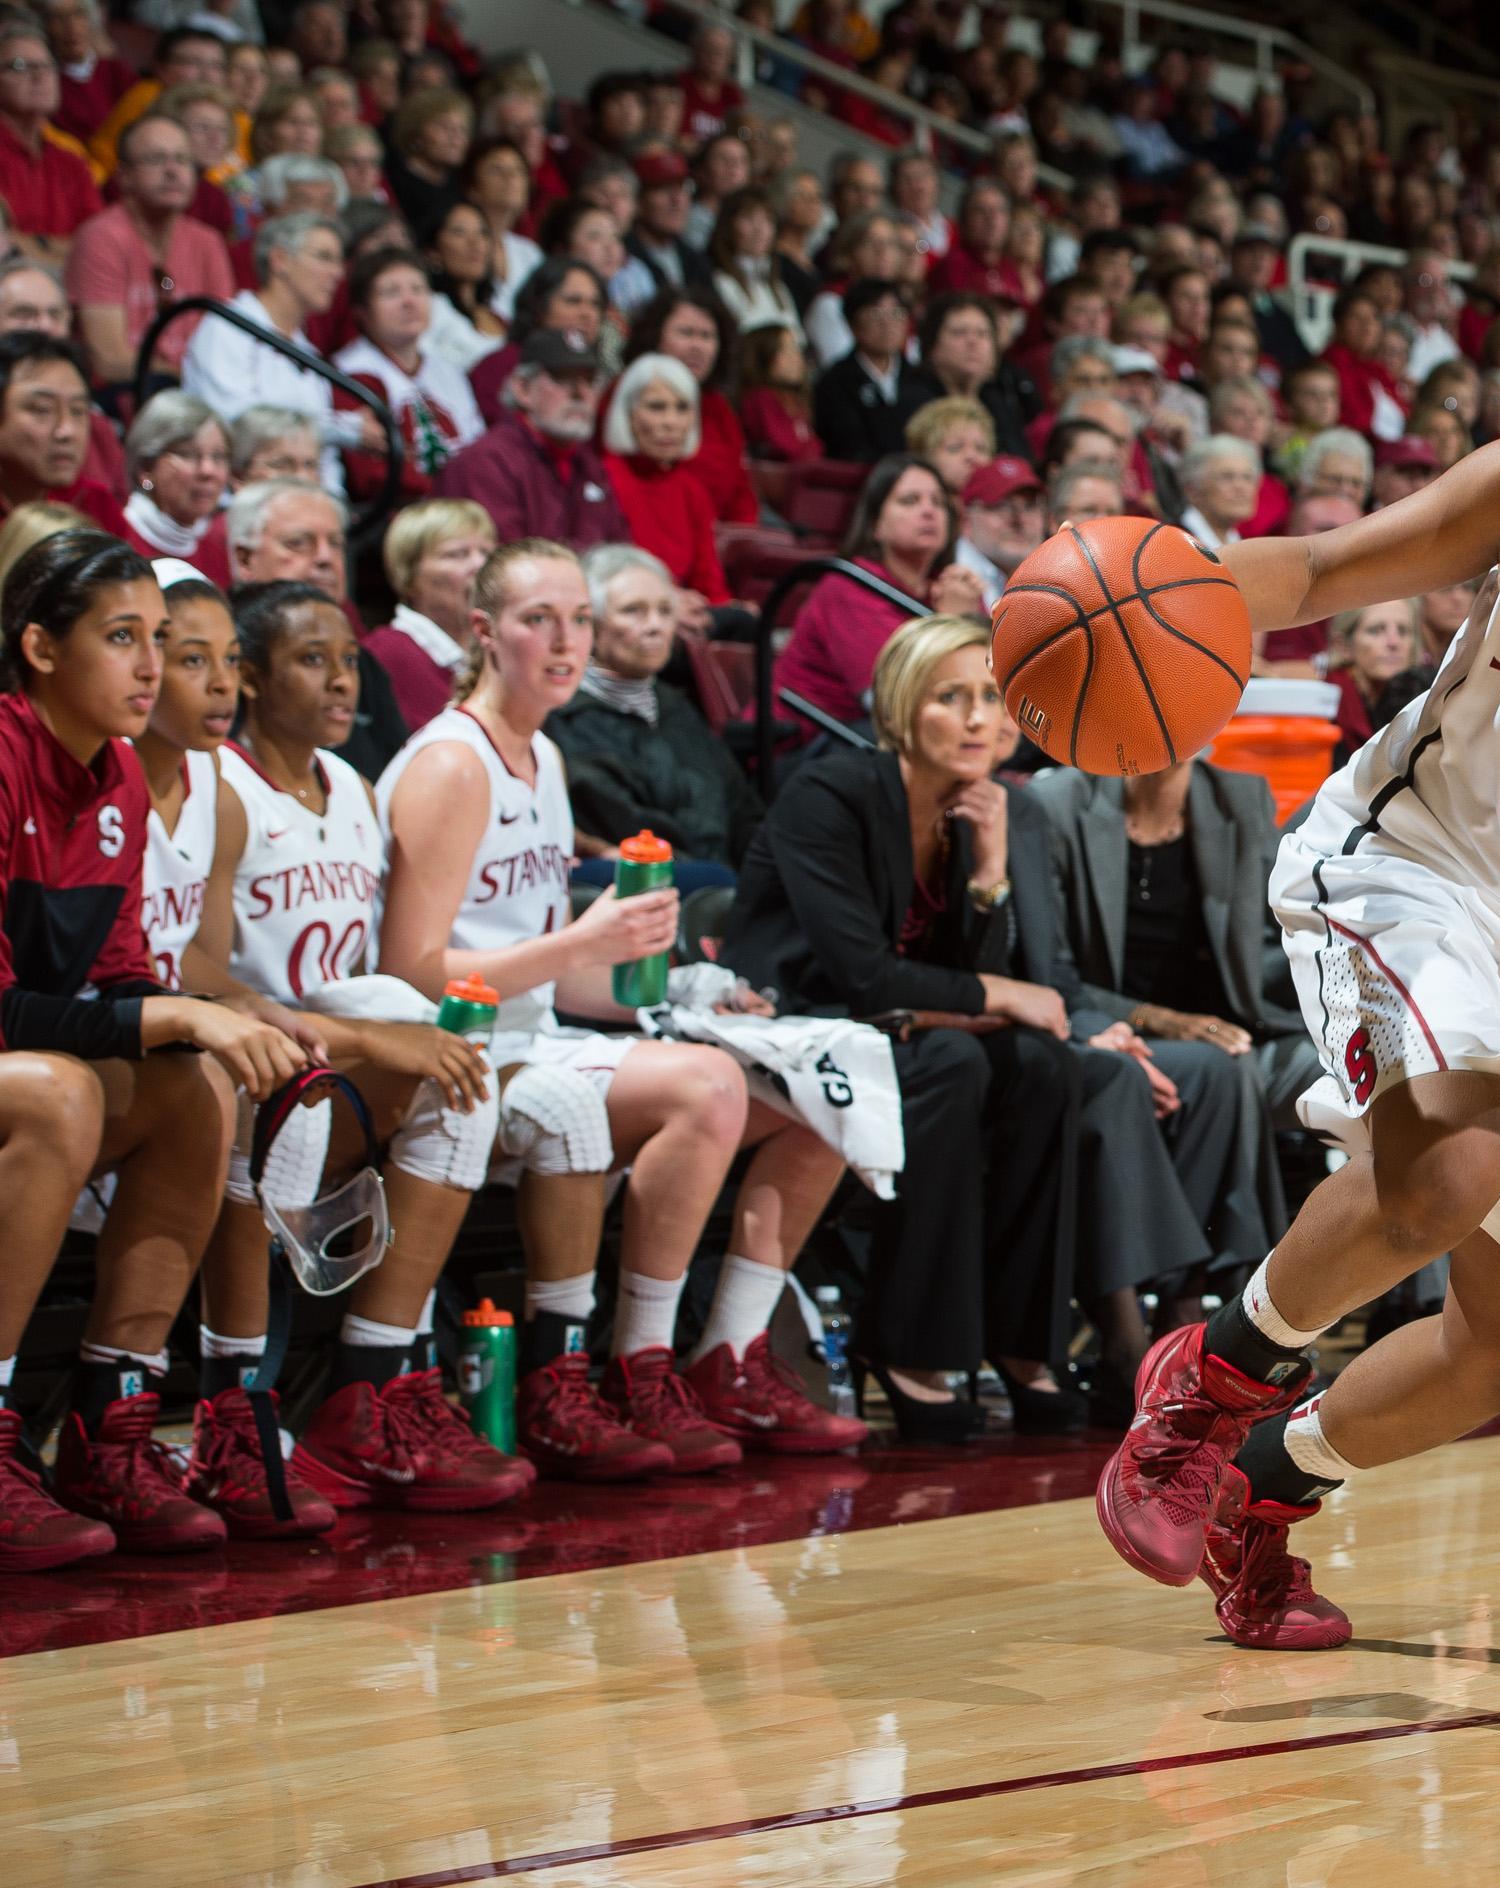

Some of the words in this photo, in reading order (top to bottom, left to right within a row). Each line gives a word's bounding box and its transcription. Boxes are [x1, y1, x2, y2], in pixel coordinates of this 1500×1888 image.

[99, 805, 125, 858] S
[288, 920, 365, 999] 00
[816, 1051, 854, 1108] GA
[1345, 1028, 1379, 1106] S
